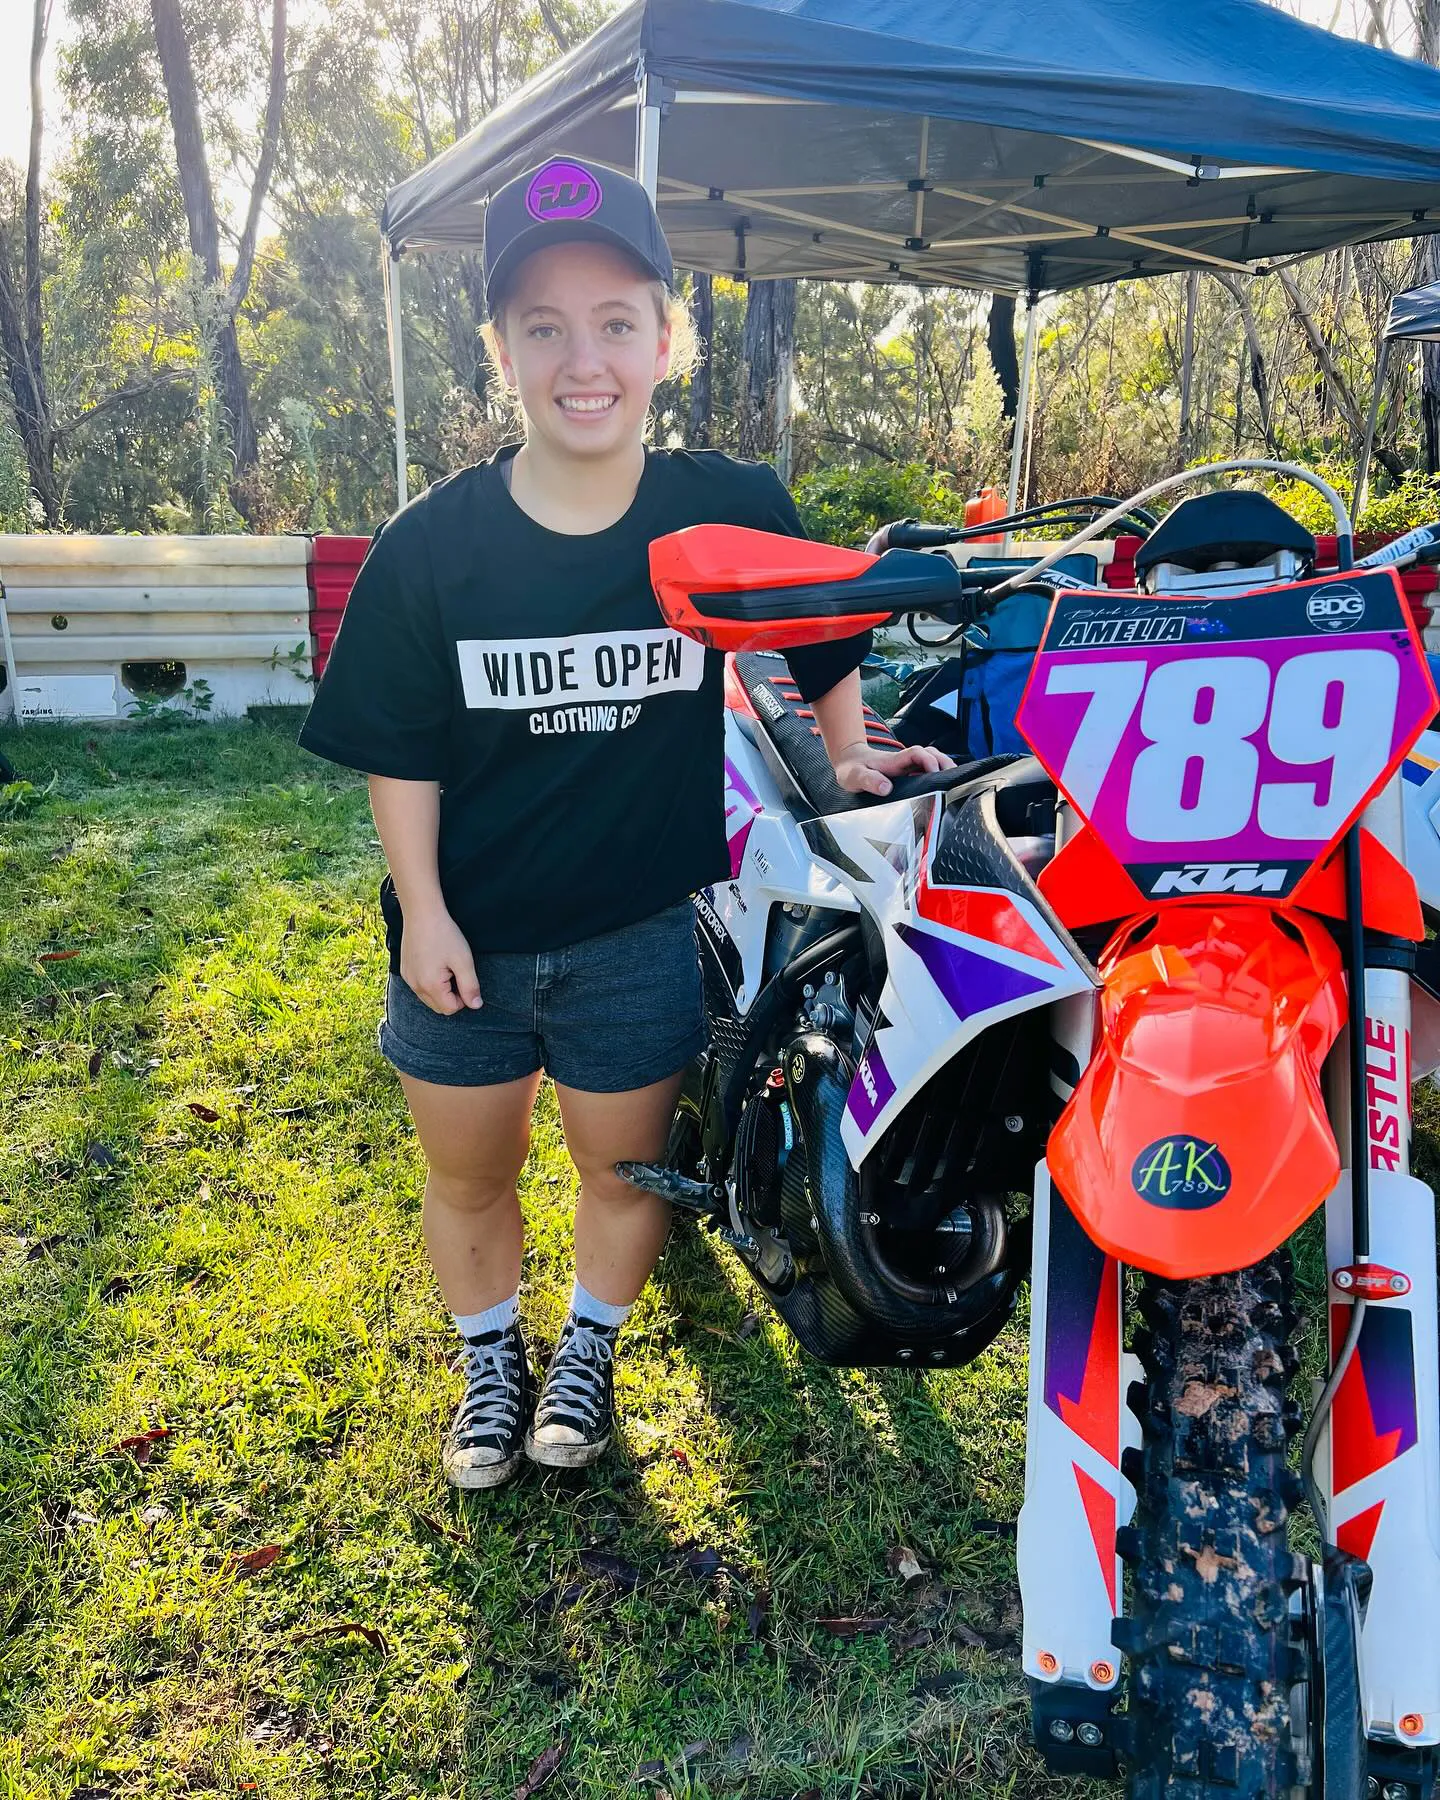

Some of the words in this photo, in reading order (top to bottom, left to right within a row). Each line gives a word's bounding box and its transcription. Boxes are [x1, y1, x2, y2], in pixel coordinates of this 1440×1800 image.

[1307, 596, 1364, 616] BDG
[1058, 616, 1187, 647] AMELIA
[482, 648, 579, 697] WIDE
[594, 637, 682, 688] OPEN
[529, 704, 617, 735] CLOTHING
[621, 703, 642, 729] CO
[1044, 649, 1400, 843] 789
[1150, 863, 1288, 894] KTM
[692, 893, 728, 944] MOTOREX
[859, 1057, 879, 1108] KTM
[1138, 1141, 1226, 1196] AK
[1171, 1180, 1209, 1194] 789
